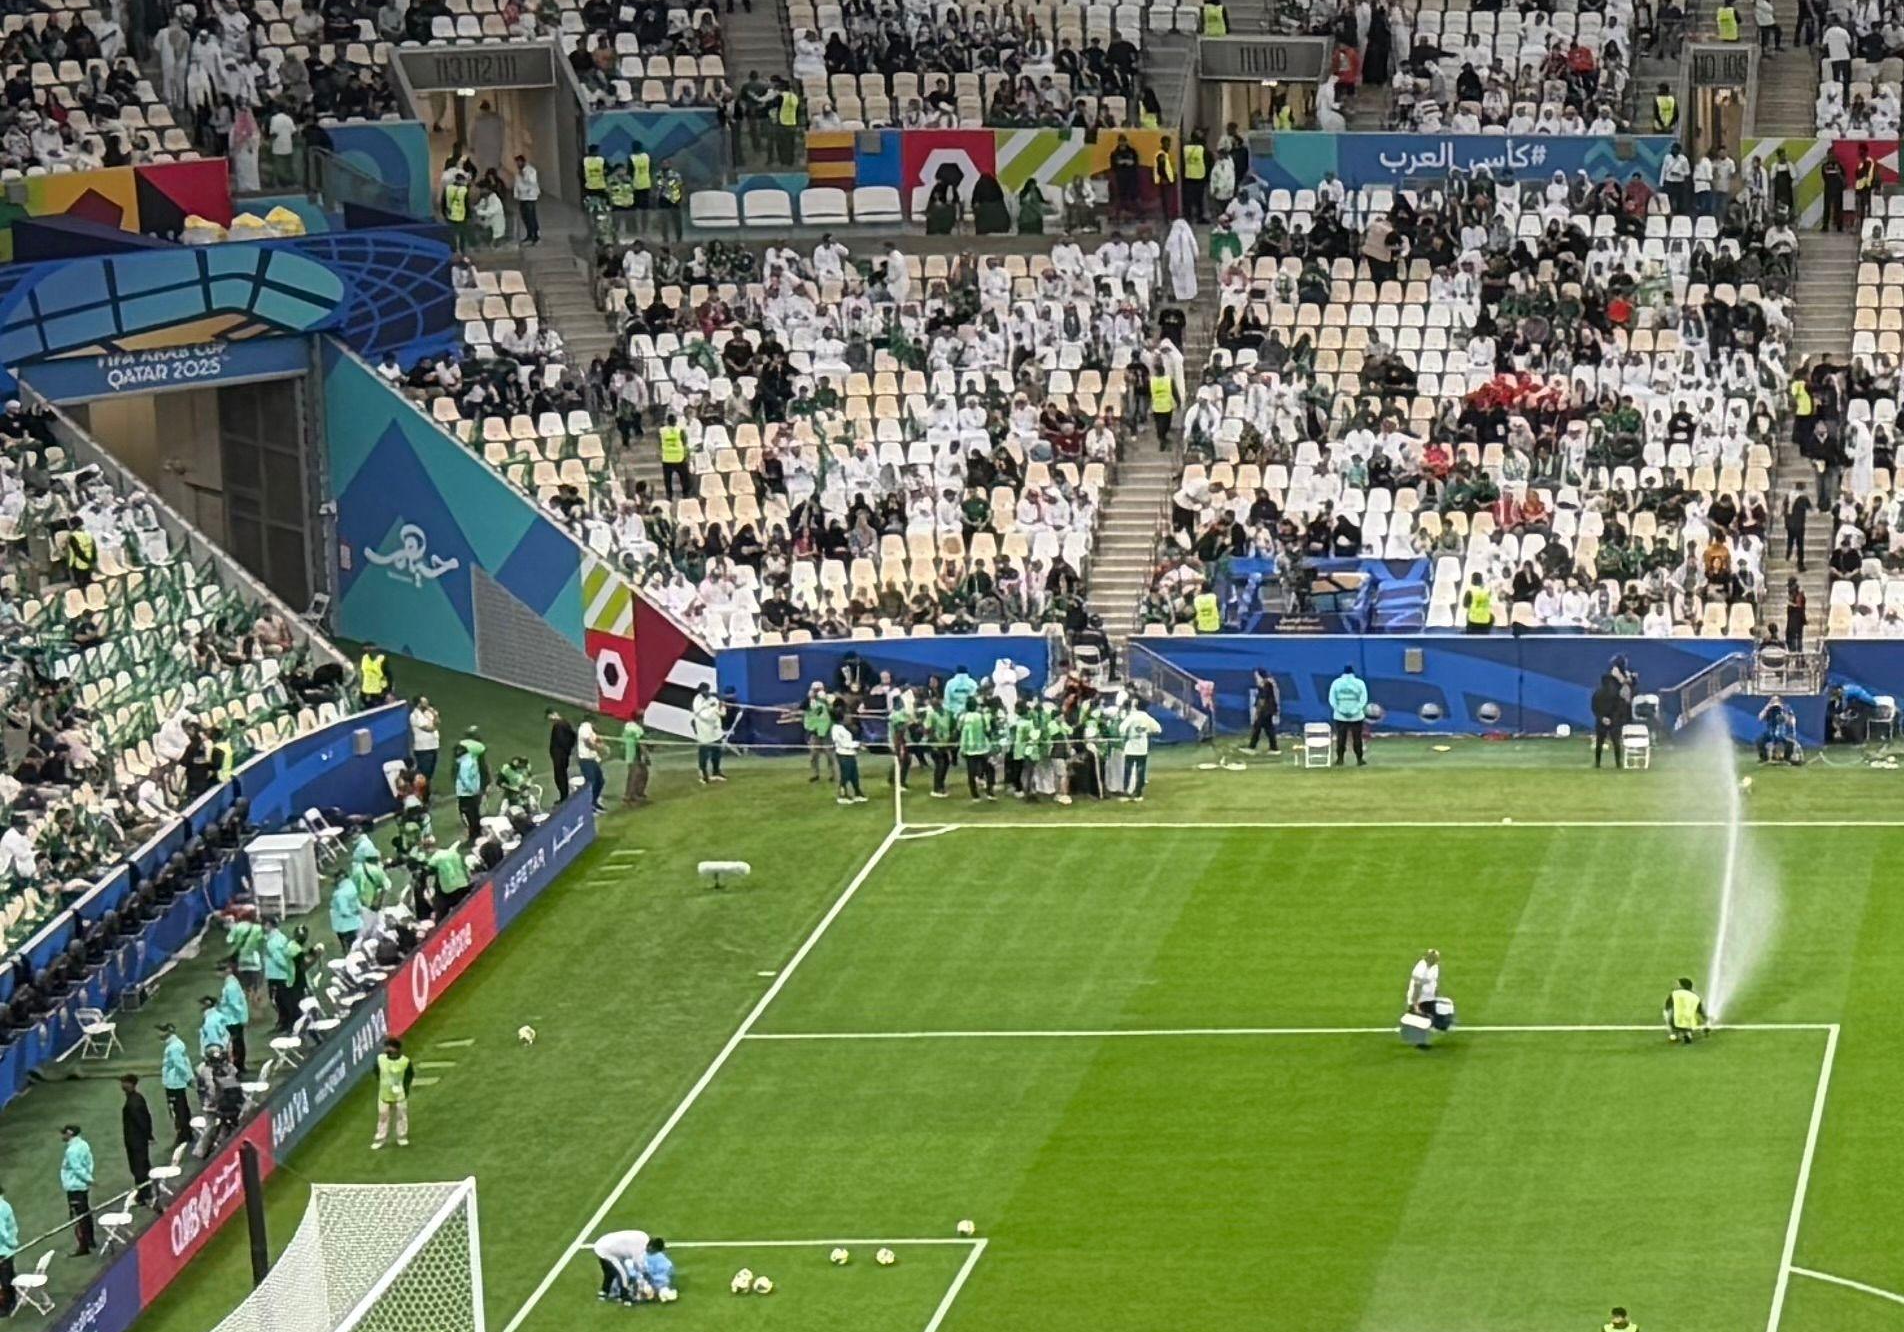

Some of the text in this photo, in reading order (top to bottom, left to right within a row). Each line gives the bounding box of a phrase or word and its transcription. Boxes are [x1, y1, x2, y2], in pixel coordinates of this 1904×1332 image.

[434, 54, 517, 84] 113 112 111
[1263, 46, 1287, 72] 110
[1380, 138, 1547, 174] #كأس_العرب
[107, 364, 168, 391] QATAR
